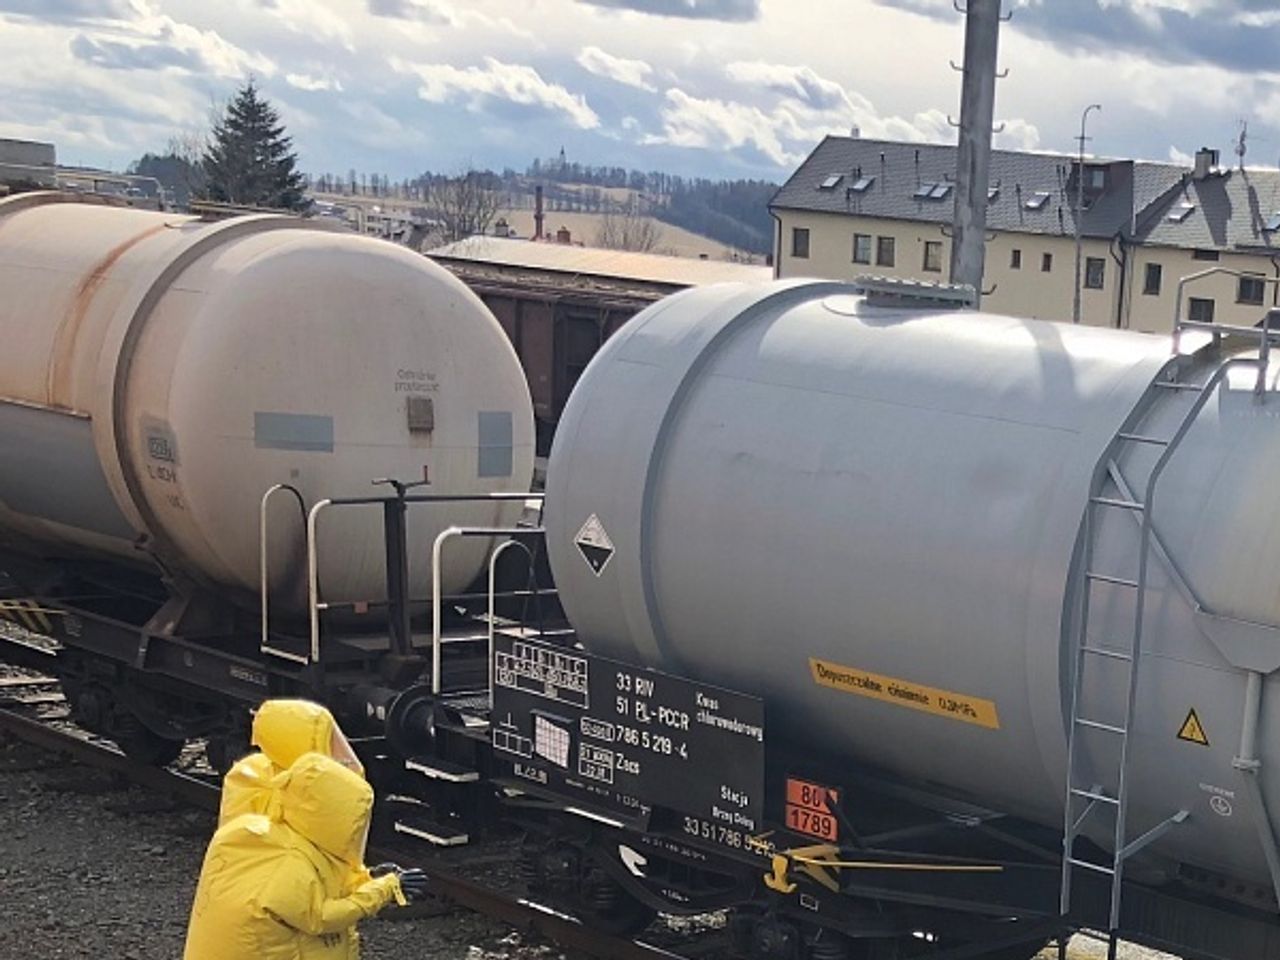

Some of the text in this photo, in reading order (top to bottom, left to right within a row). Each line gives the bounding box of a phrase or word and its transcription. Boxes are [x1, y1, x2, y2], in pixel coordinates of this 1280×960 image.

[616, 672, 654, 698] 33 RIV
[616, 696, 629, 715] 51
[616, 725, 639, 746] 786
[641, 732, 650, 748] 5
[791, 809, 831, 836] 1789
